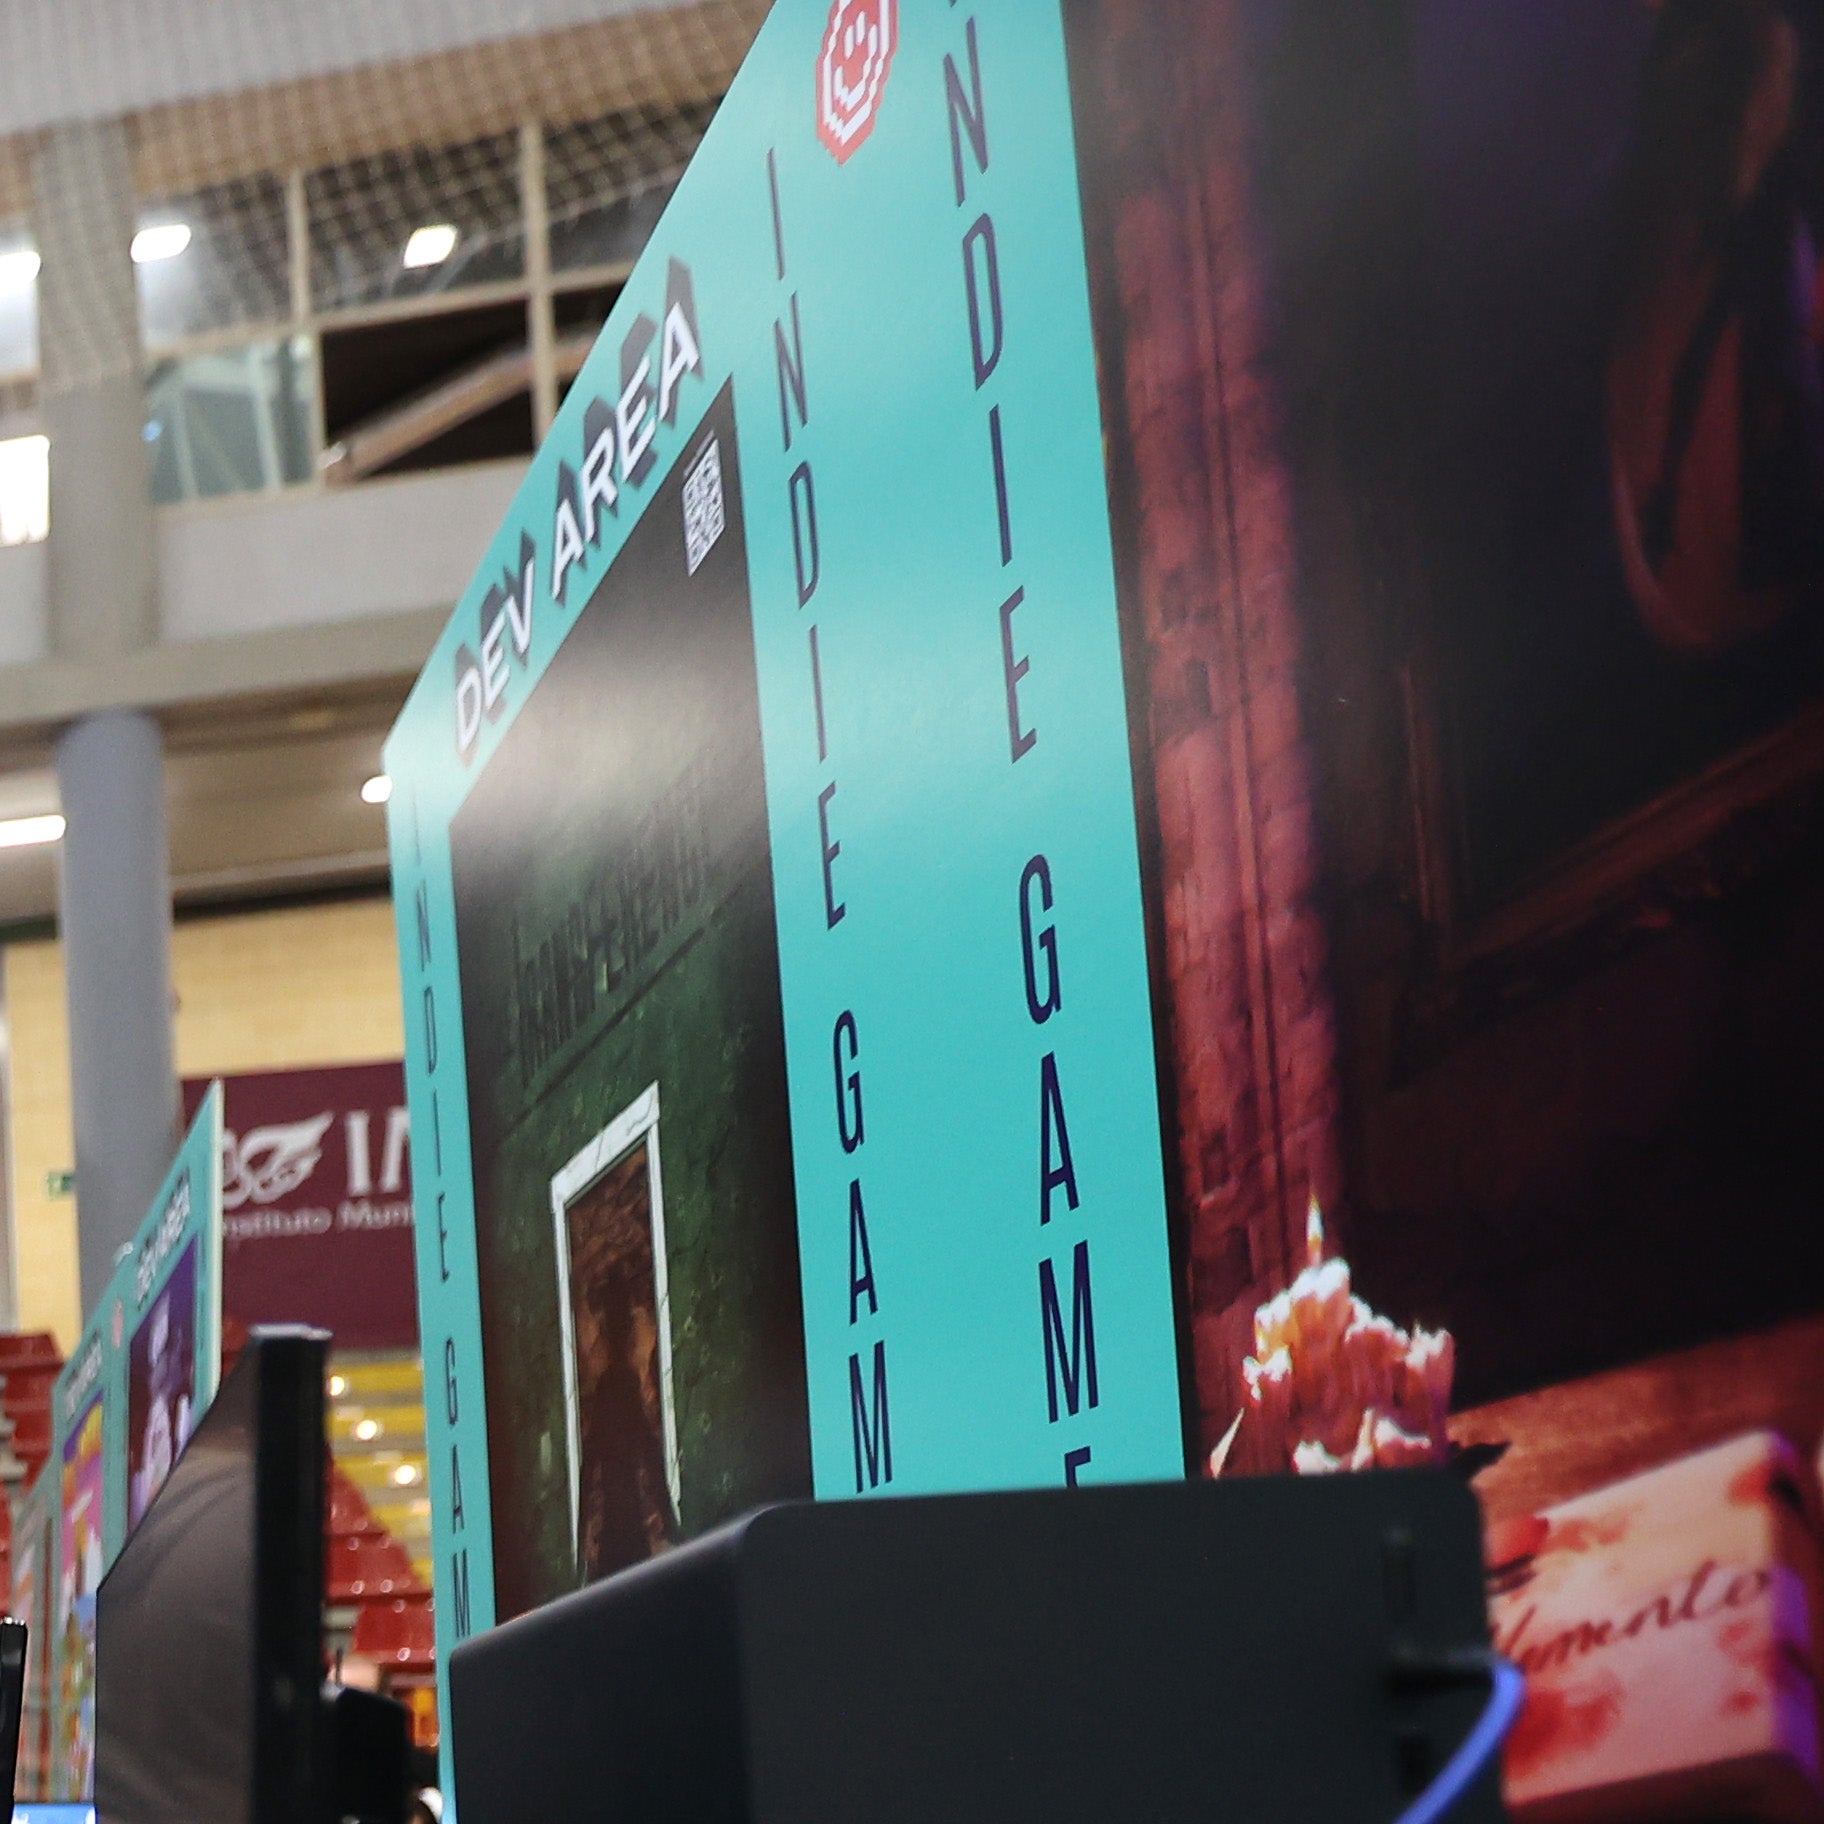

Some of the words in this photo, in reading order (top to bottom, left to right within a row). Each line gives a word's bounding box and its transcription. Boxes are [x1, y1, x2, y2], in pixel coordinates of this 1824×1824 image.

[455, 548, 535, 764] DEV
[551, 296, 701, 602] AREA
[767, 147, 847, 931] INDIE
[941, 0, 1038, 764] NDIE
[1017, 853, 1101, 1488] GAM
